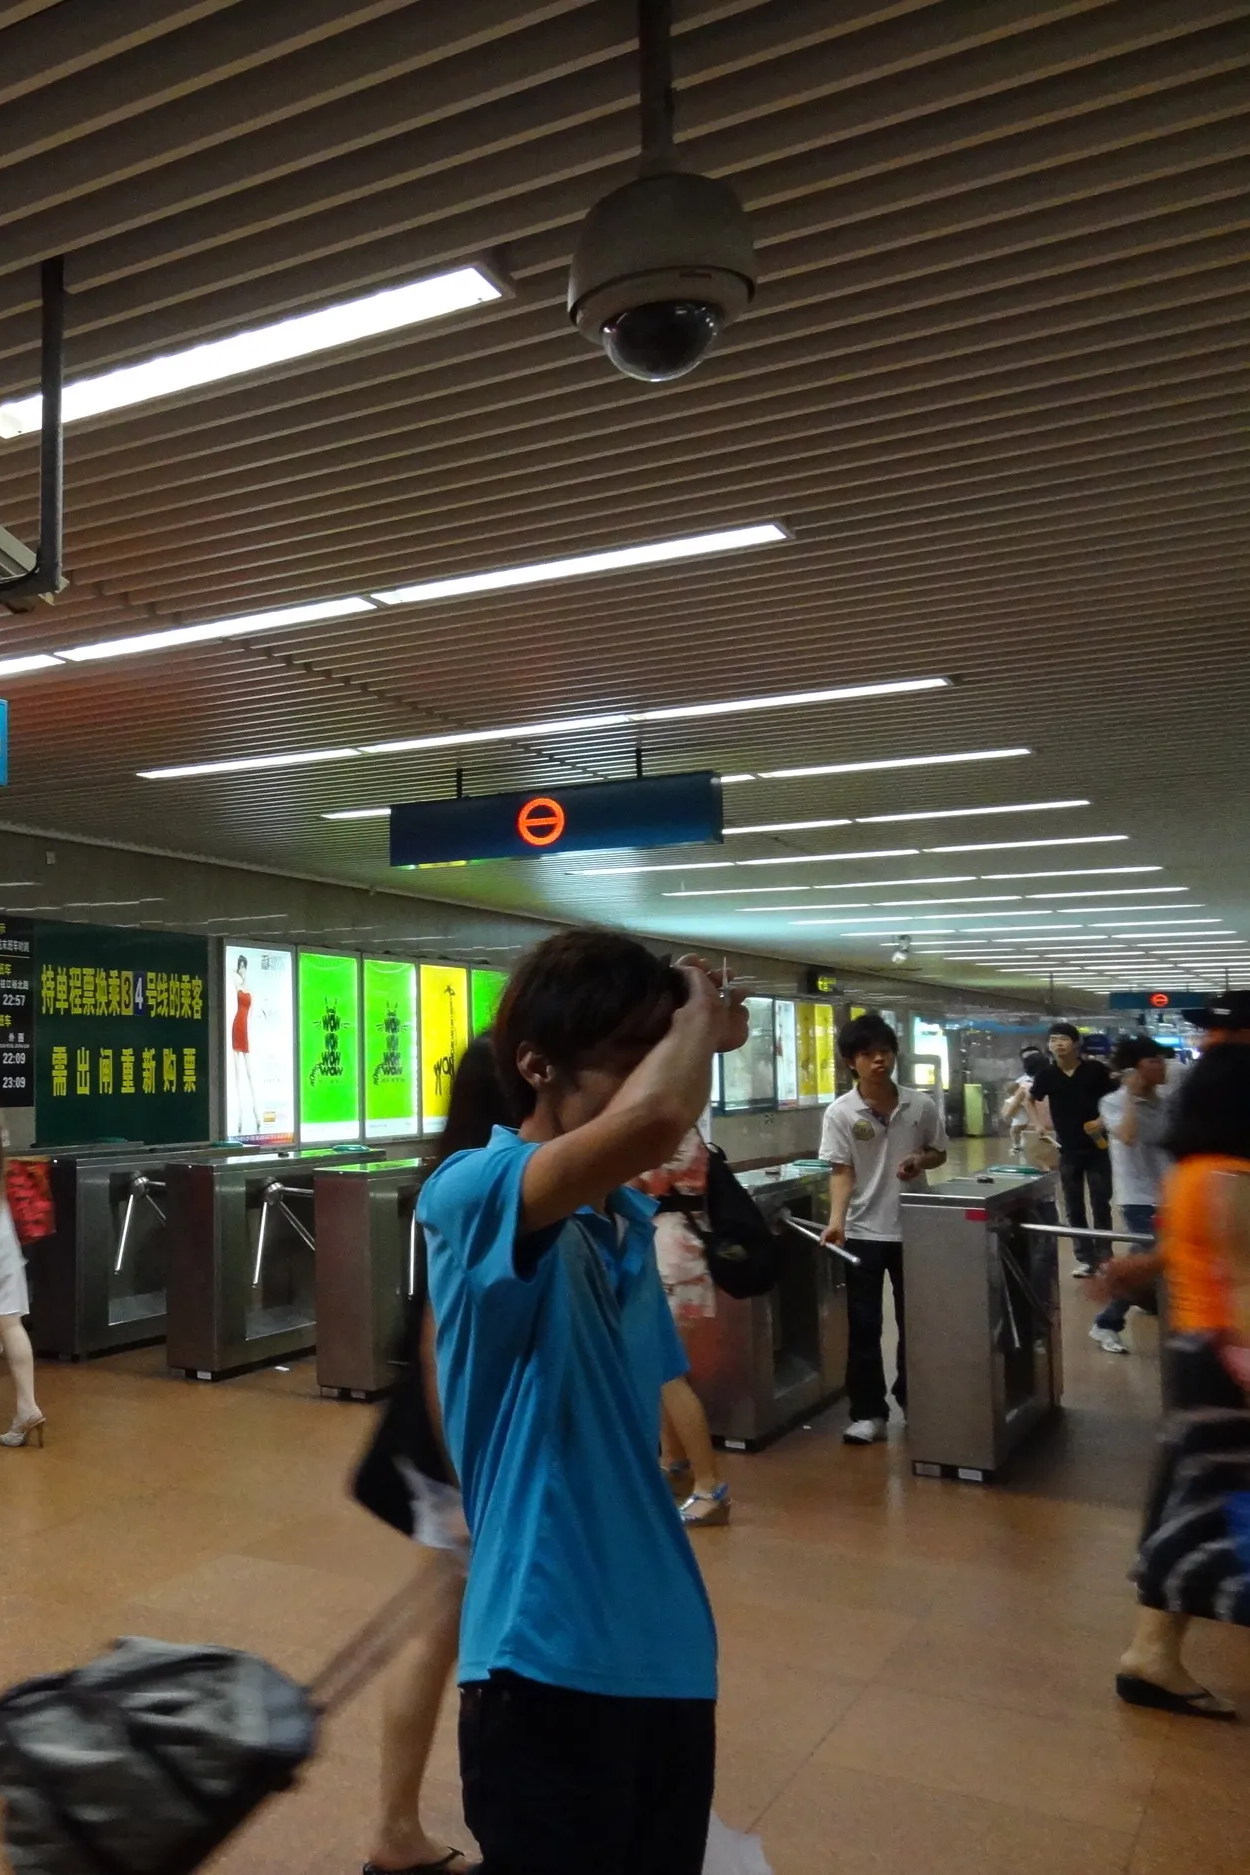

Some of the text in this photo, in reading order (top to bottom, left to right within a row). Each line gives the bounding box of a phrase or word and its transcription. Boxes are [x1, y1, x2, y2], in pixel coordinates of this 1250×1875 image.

[2, 994, 26, 1006] 22:57
[2, 1052, 26, 1064] 22:09
[2, 1076, 26, 1089] 23:09
